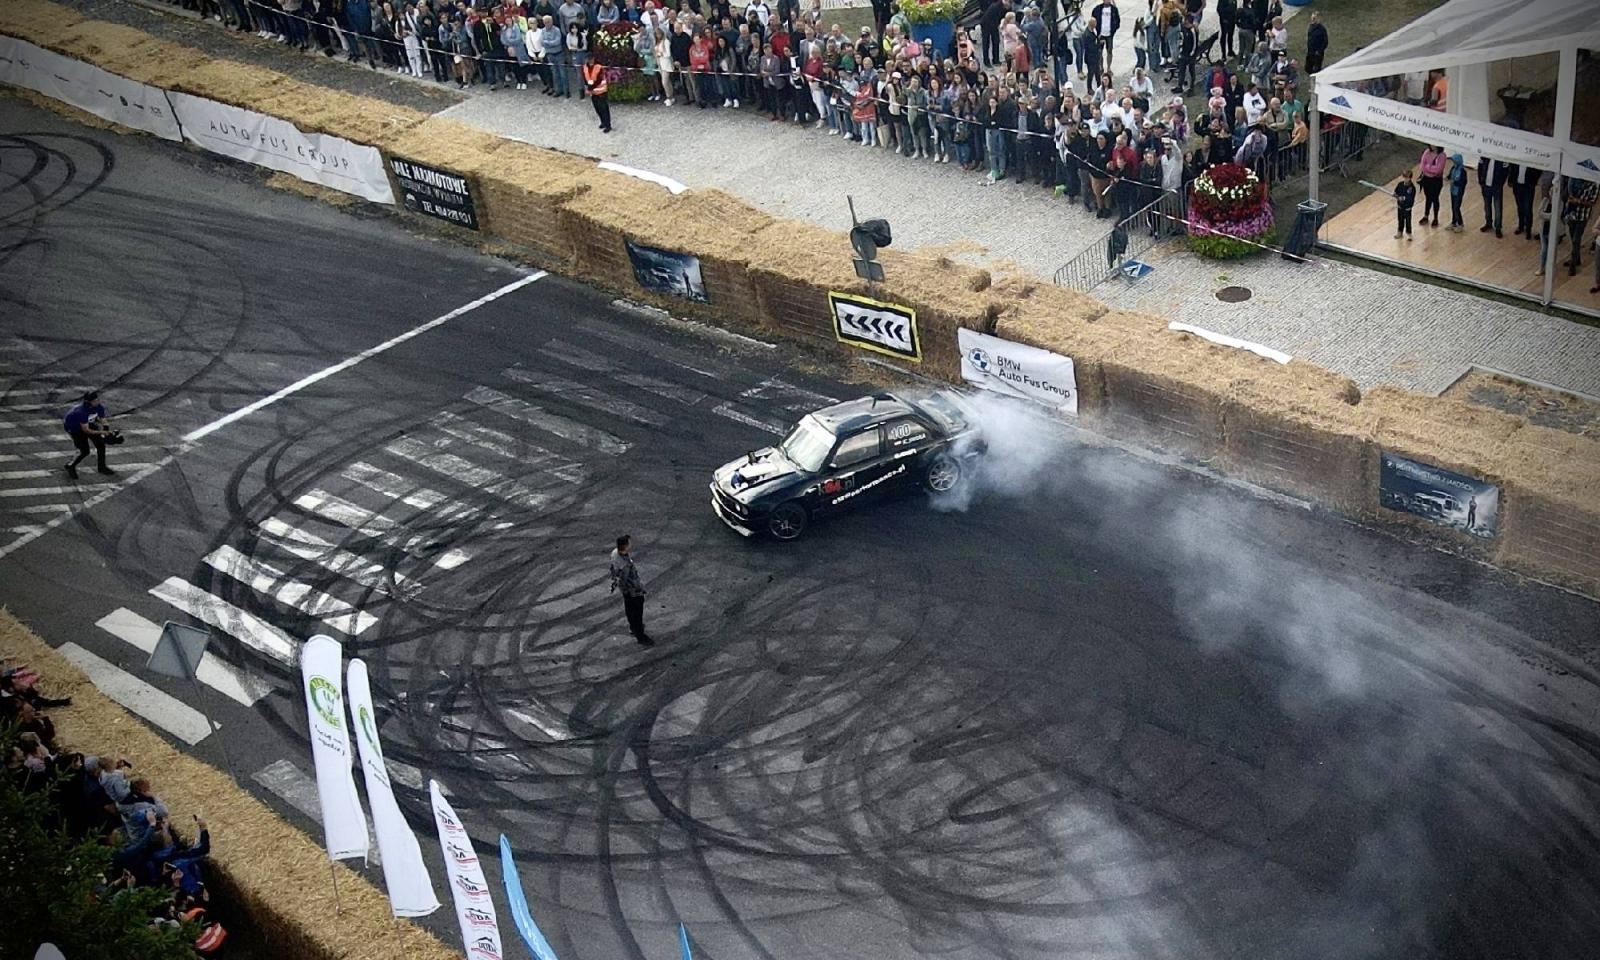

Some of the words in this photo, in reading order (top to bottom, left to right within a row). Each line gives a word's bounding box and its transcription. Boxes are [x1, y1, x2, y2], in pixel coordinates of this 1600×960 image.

[209, 120, 250, 141] AUTO
[260, 133, 288, 151] FUS
[297, 145, 349, 169] GROUP
[997, 355, 1021, 370] BMW
[999, 368, 1022, 383] Auto
[1023, 375, 1041, 389] Fus
[1041, 381, 1071, 399] Group
